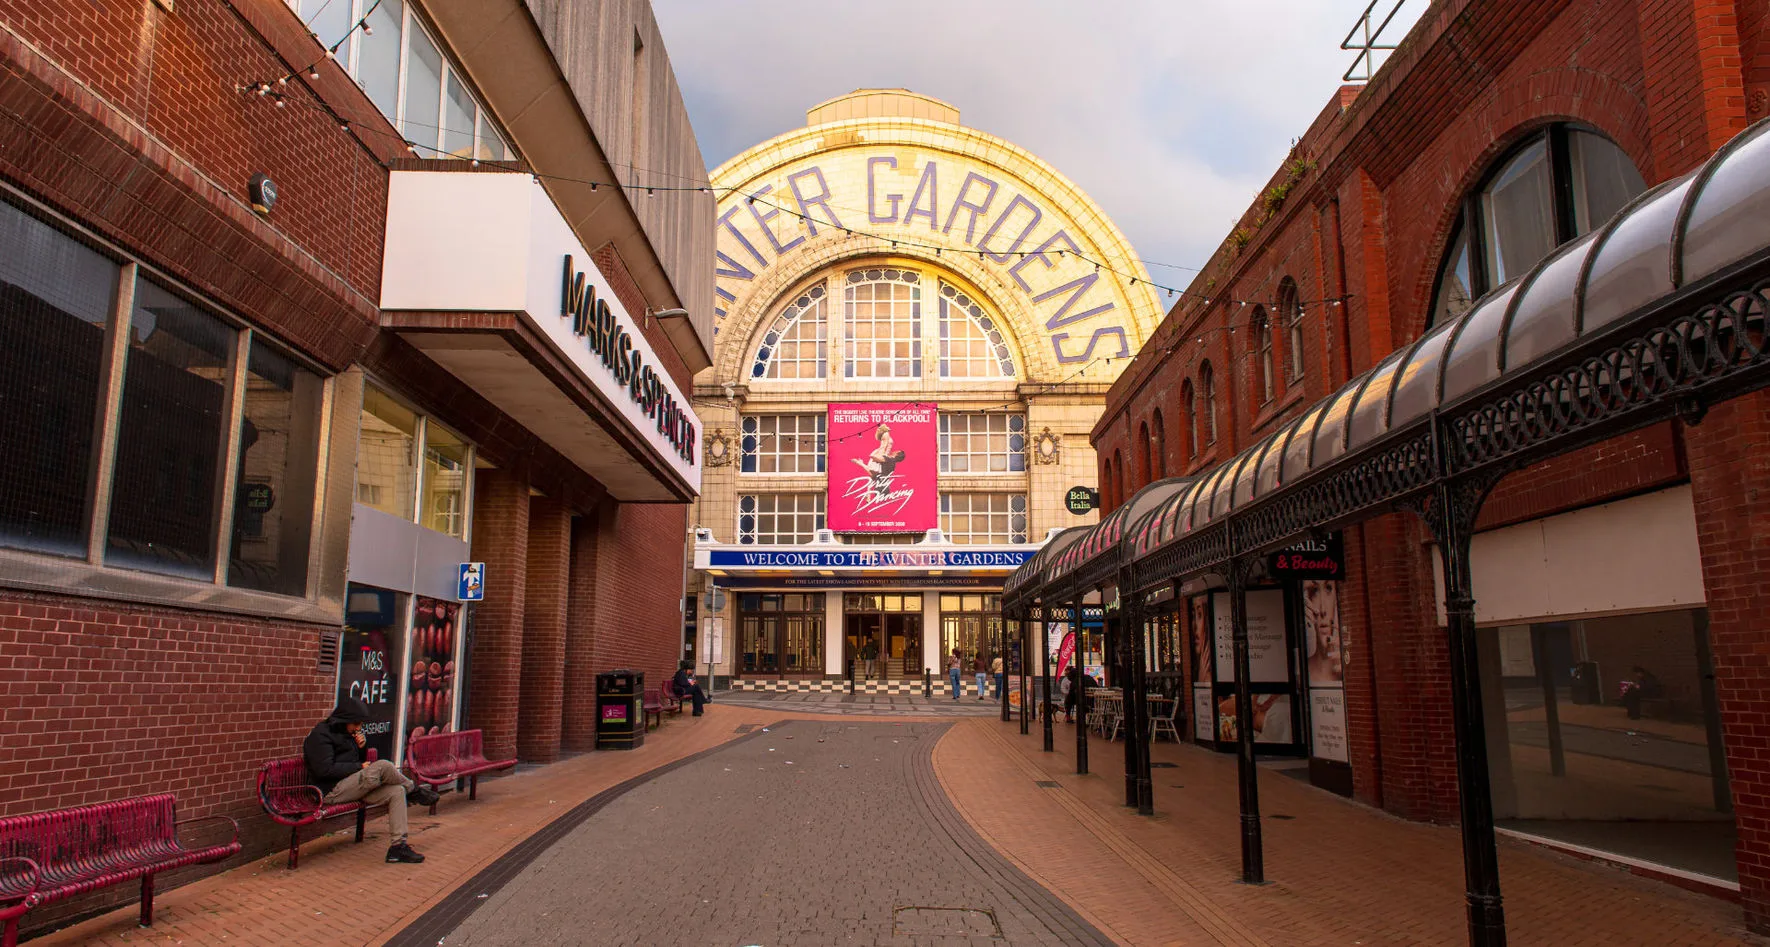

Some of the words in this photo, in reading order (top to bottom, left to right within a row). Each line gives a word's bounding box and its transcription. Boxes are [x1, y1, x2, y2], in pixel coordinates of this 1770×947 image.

[713, 166, 842, 335] NTER
[867, 156, 1129, 364] GARDENS
[834, 414, 869, 423] RETURNS
[871, 414, 882, 423] TO
[883, 414, 930, 423] BLACKPOOL!
[841, 471, 906, 498] Dirty
[851, 483, 914, 516] Dancing
[1070, 491, 1090, 500] Bella
[1070, 500, 1091, 509] Italia
[744, 553, 819, 566] WELCOME
[824, 553, 845, 566] TO
[848, 553, 880, 566] THE
[885, 553, 947, 566] WINTER
[951, 553, 1024, 566] GARDENS
[1276, 554, 1289, 569] &
[1291, 554, 1338, 574] Beauty
[362, 650, 384, 670] M&S
[350, 673, 388, 704] CAFÉ
